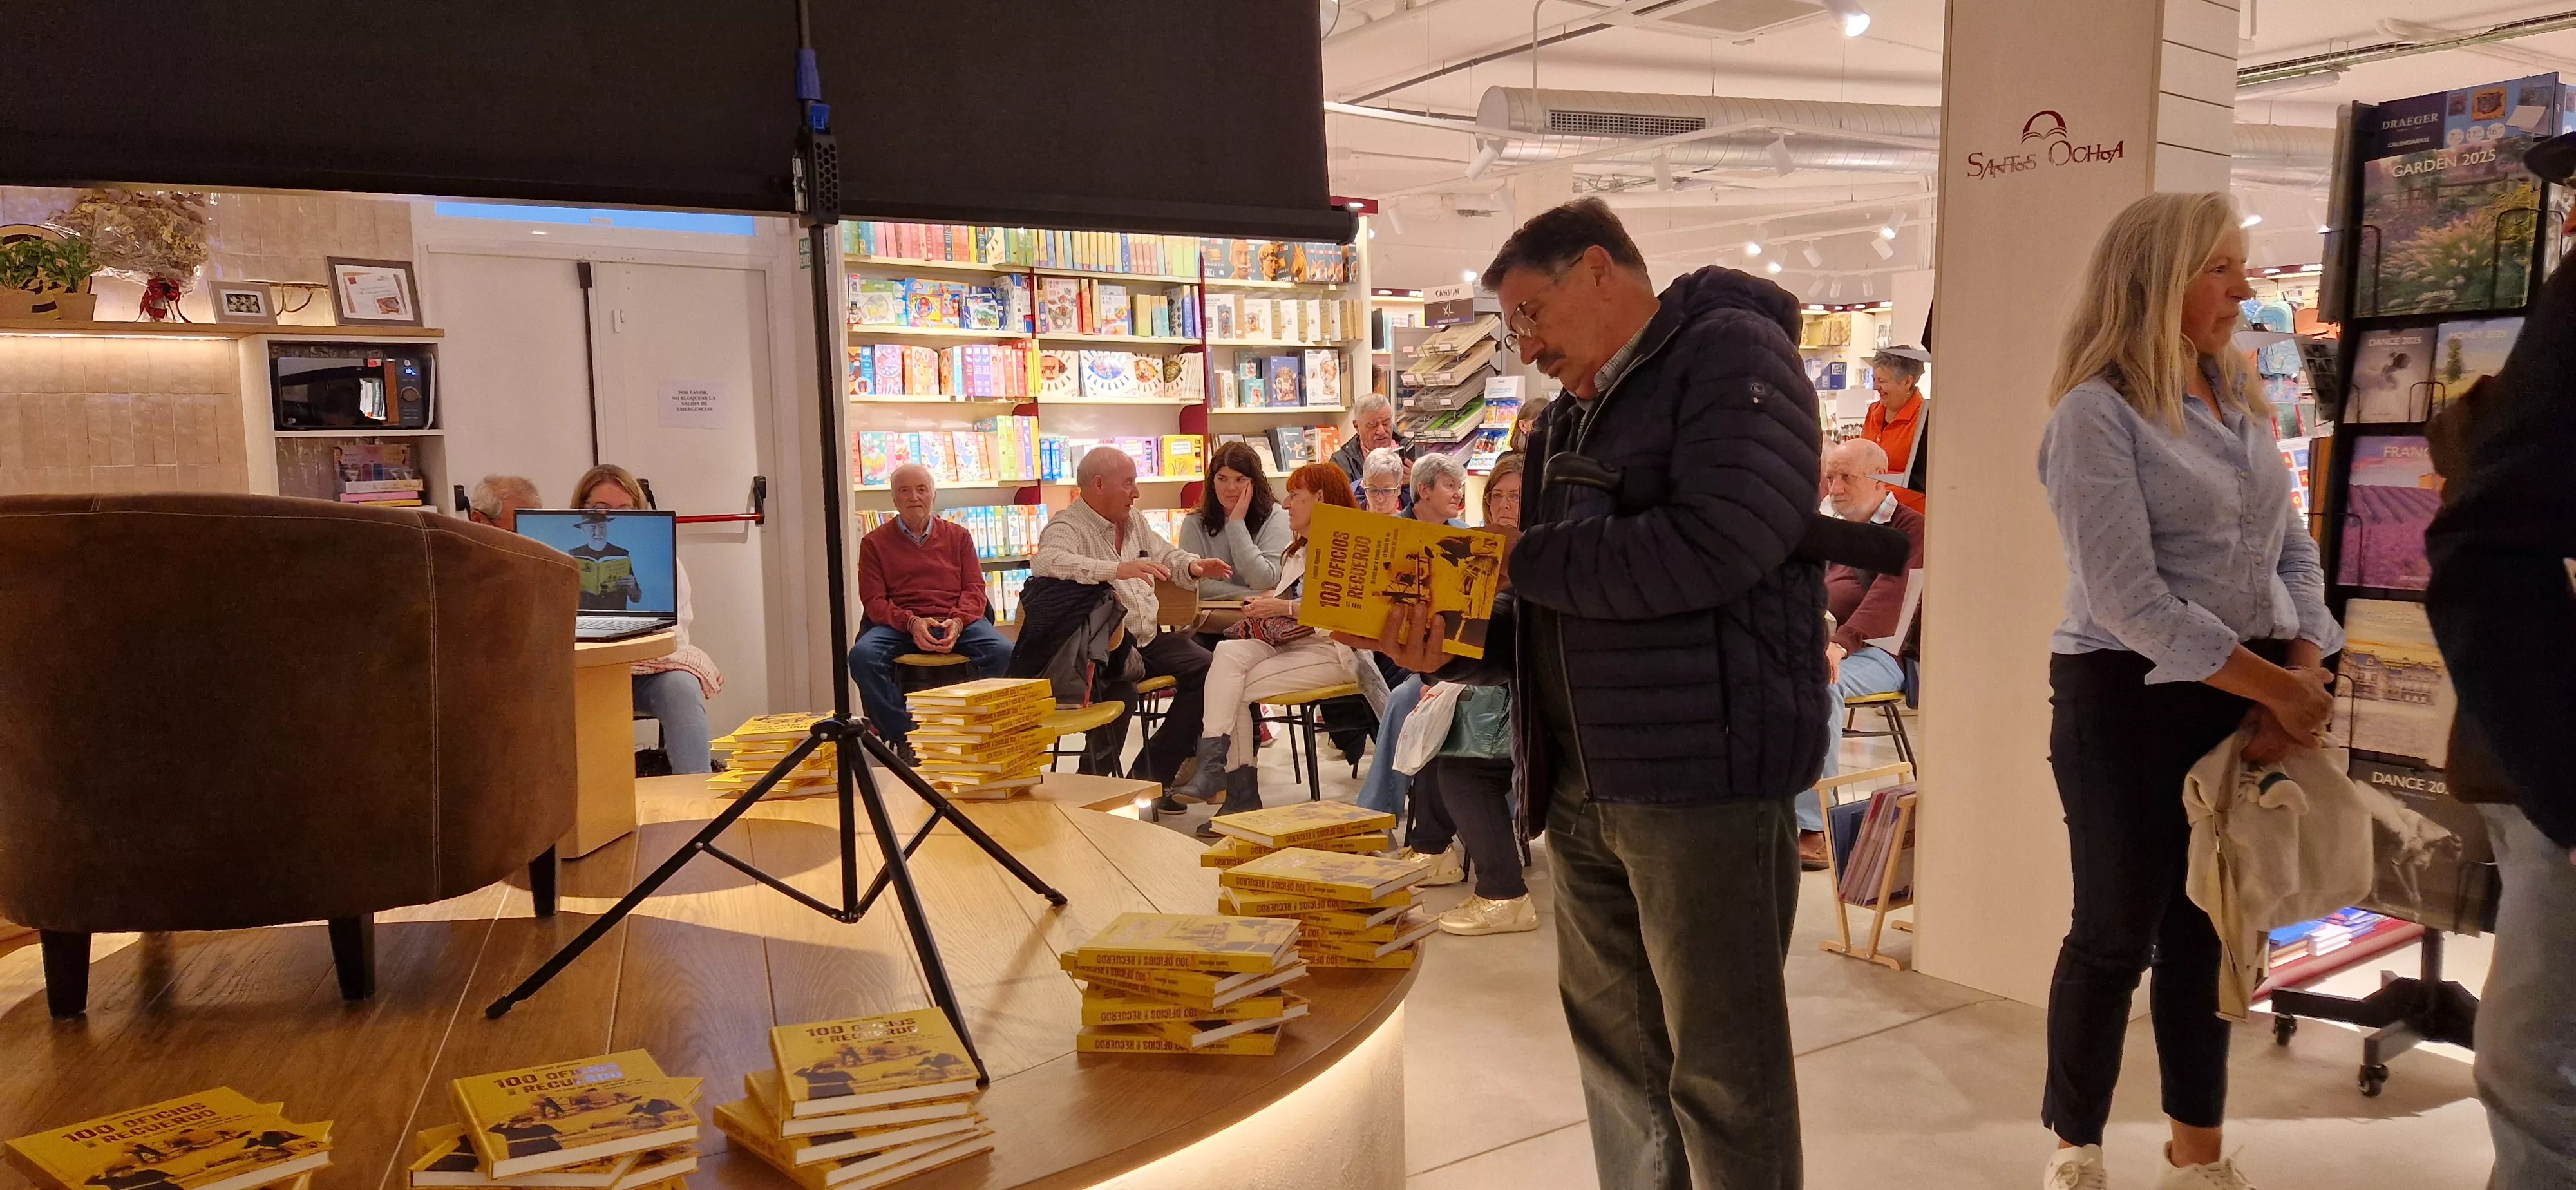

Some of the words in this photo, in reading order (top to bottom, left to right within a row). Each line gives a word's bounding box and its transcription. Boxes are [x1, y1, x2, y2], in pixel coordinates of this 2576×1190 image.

[2382, 113, 2439, 130] DRAEGER
[2047, 140, 2124, 167] OCHOA
[2391, 155, 2457, 178] GARDEN
[2462, 149, 2496, 166] 2025
[1443, 302, 1454, 317] XL
[2369, 337, 2400, 346] DANCE
[2383, 446, 2429, 458] FRANC
[1328, 531, 1350, 578] OFICIOS
[1347, 536, 1371, 599] RECUERDO
[1319, 581, 1342, 607] 100
[2372, 771, 2425, 791] DANCE
[2427, 780, 2450, 795] 20
[1236, 876, 1265, 887] RECUERDO
[1271, 881, 1294, 890] OFICIOS
[1256, 903, 1291, 913] RECUERDO
[1299, 900, 1325, 909] OFICIOS
[1097, 954, 1135, 965] RECUERDO
[1144, 956, 1173, 966] OFICIOS
[1175, 957, 1188, 967] 100
[1101, 1010, 1142, 1021] RECUERDO
[1150, 1008, 1181, 1019] OFICIOS
[806, 1026, 844, 1037] 100
[829, 1026, 918, 1043] RECRDO
[1095, 1040, 1134, 1050] RECUERDO
[493, 1073, 538, 1088] 100
[61, 1124, 116, 1142] 100
[121, 1102, 207, 1128] OFICIOS
[102, 1110, 217, 1143] RECUERDO
